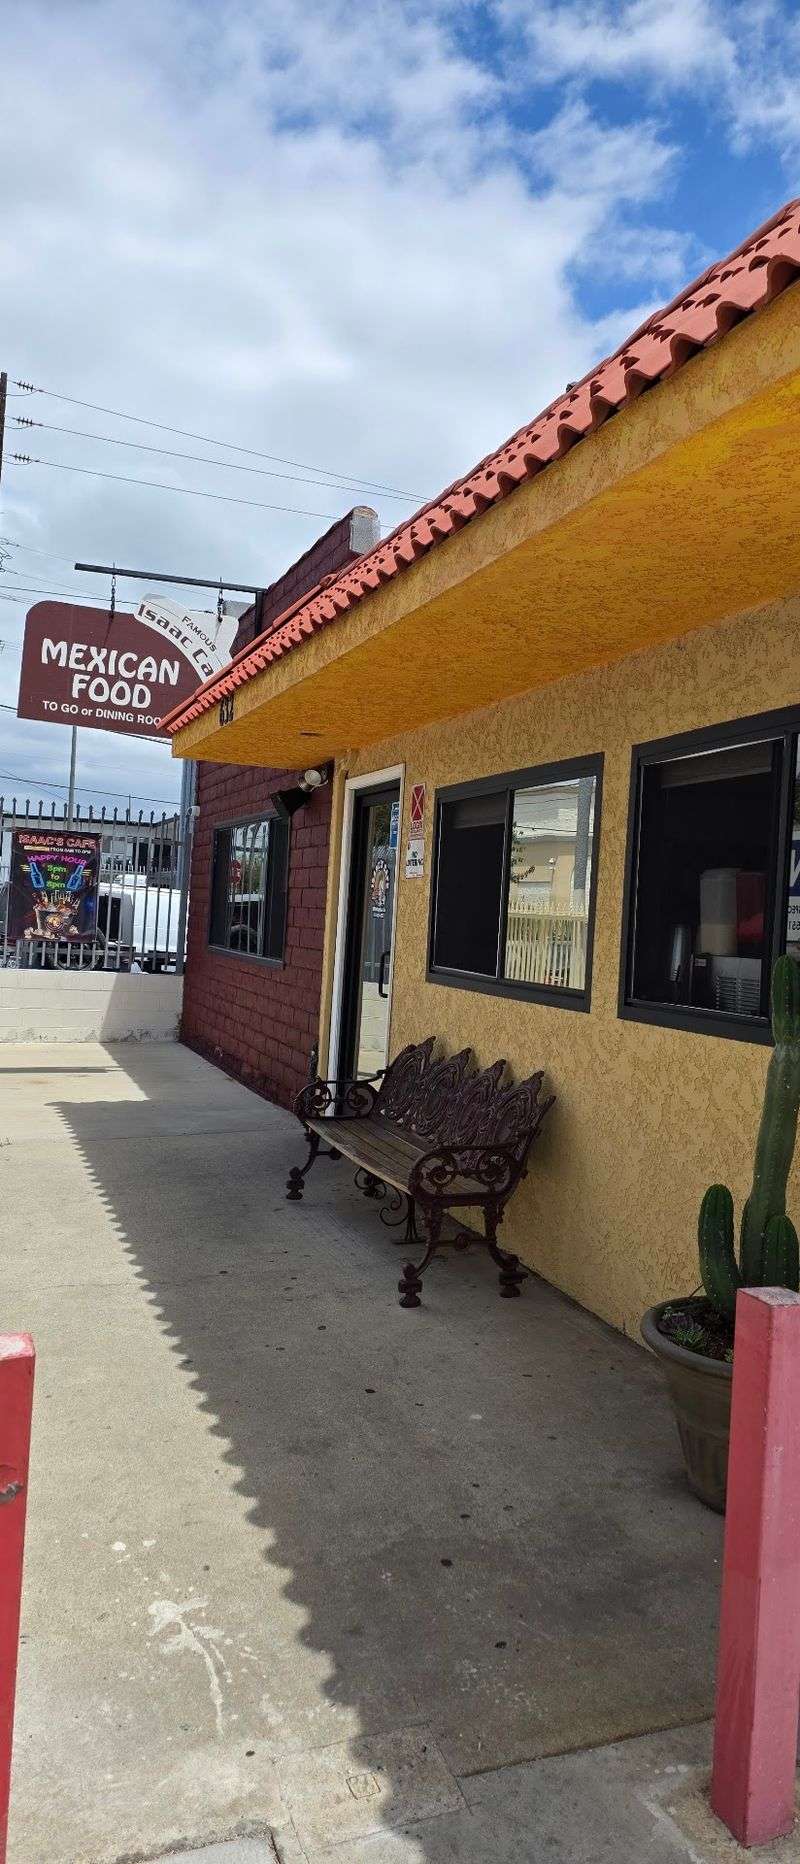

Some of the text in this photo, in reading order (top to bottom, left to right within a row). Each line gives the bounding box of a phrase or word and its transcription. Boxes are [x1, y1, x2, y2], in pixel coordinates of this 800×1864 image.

[138, 604, 214, 677] Isaac Ca
[182, 616, 217, 652] FAMOUS
[41, 637, 180, 686] MEXICAN
[71, 673, 152, 709] FOOD
[42, 700, 161, 725] TO GO or DINING ROO
[27, 854, 87, 866] HAPPY HOUR
